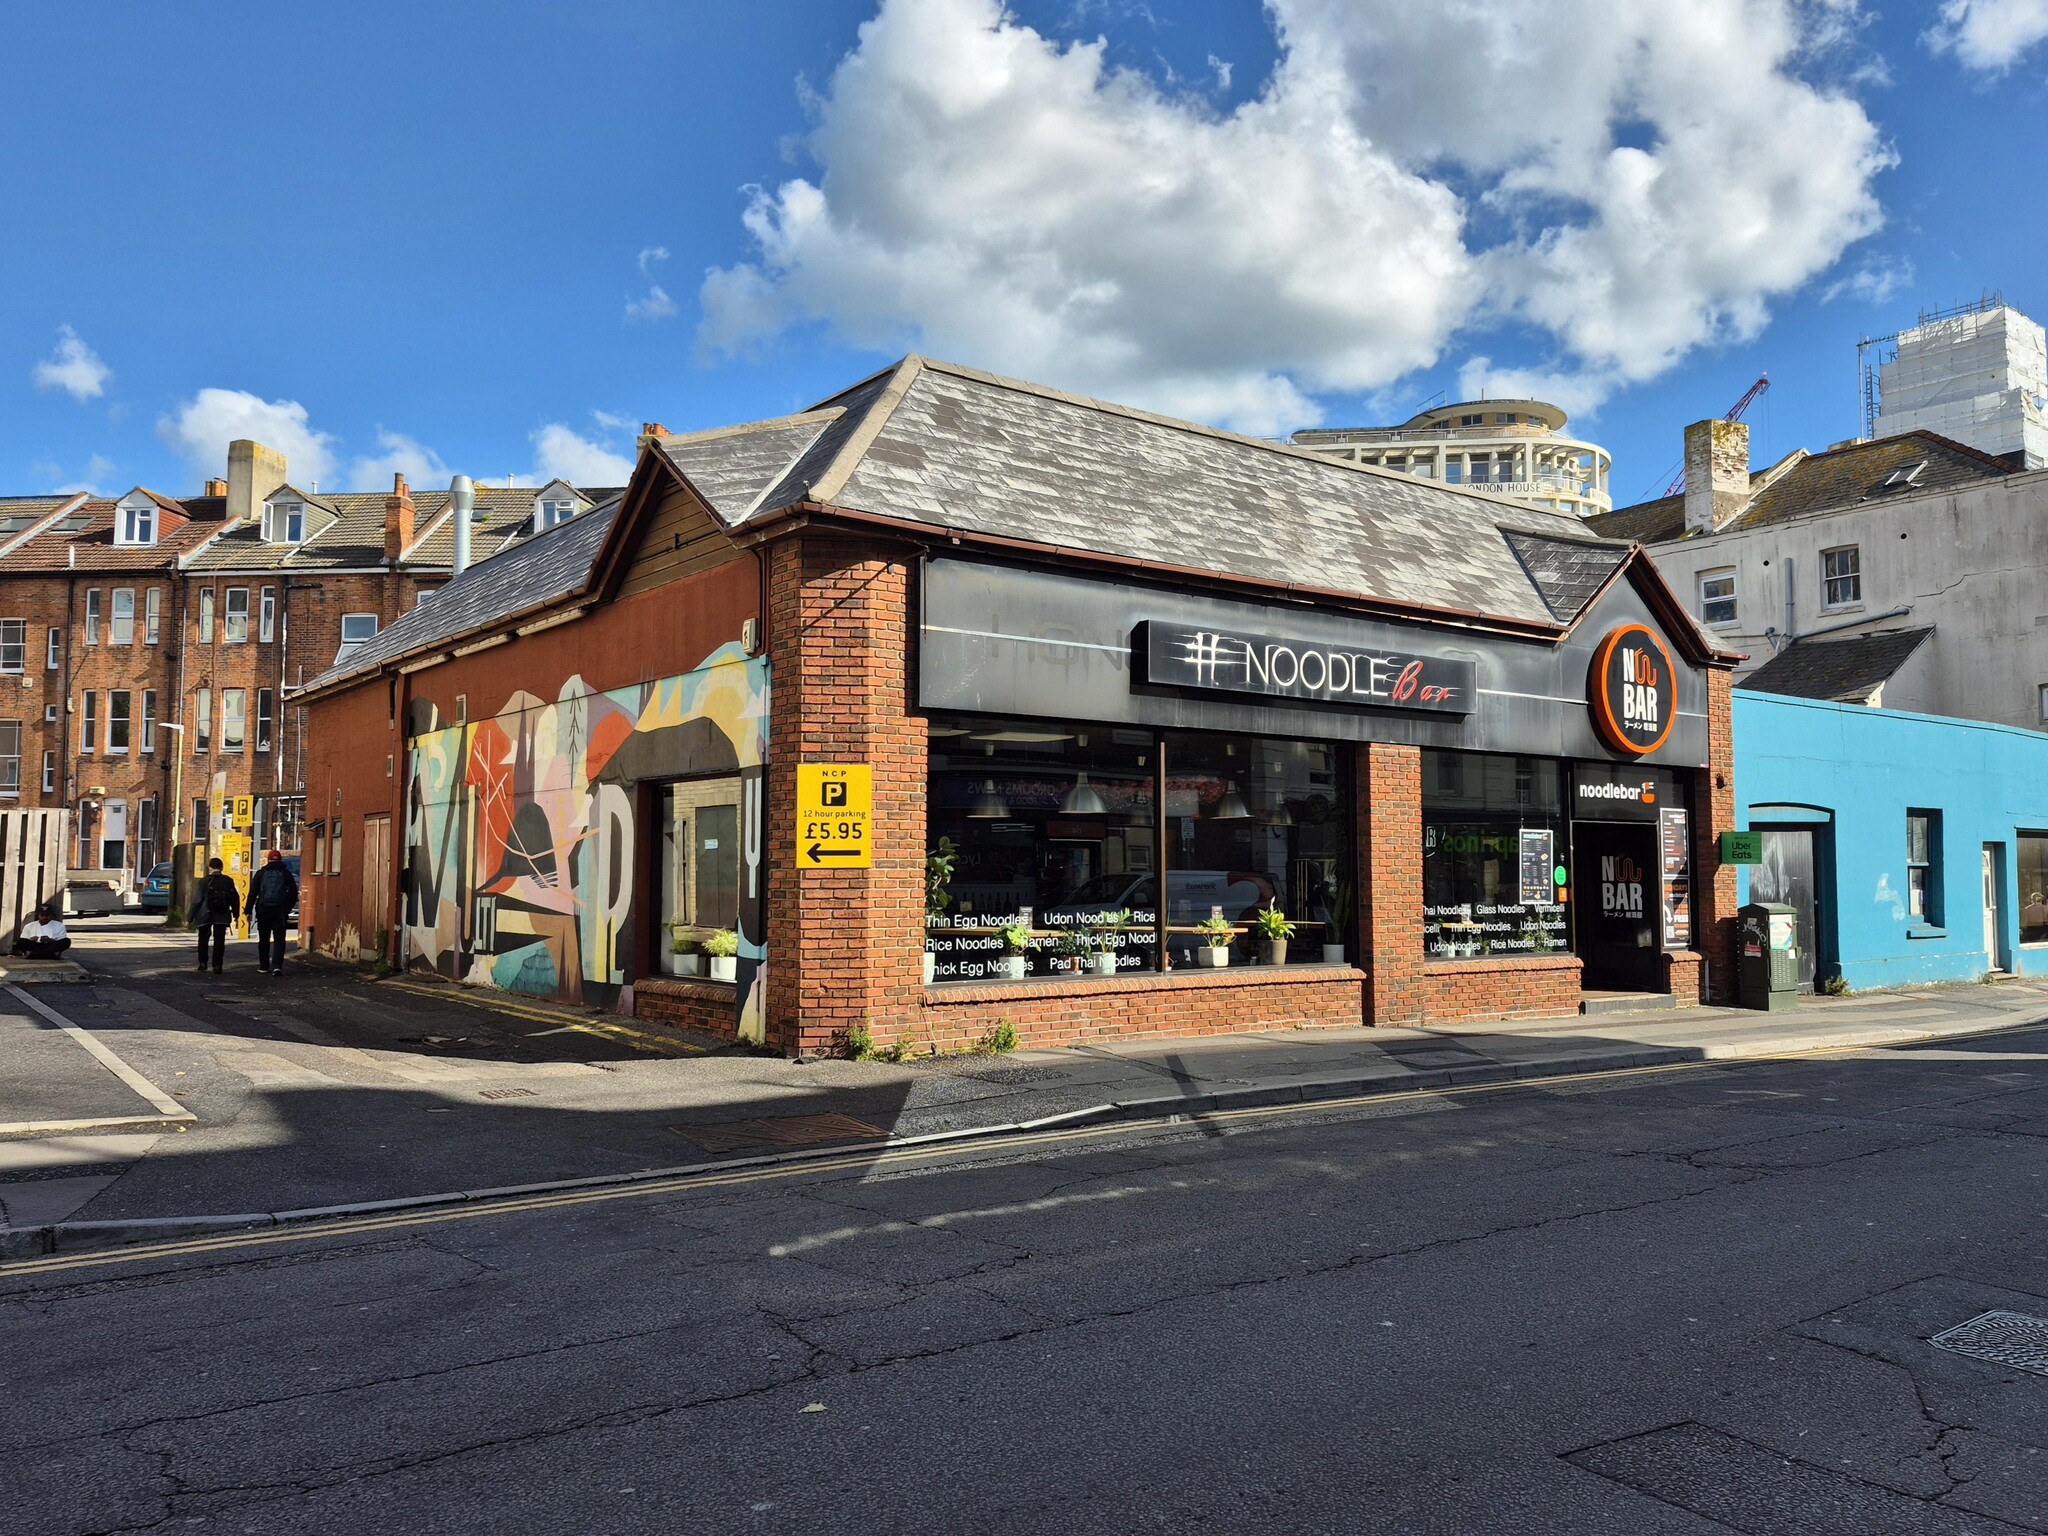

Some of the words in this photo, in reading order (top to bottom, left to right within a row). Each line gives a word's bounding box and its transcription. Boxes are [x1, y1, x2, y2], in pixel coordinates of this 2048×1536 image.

[1508, 482, 1541, 493] HOUSE
[1392, 660, 1452, 702] Bar
[1623, 683, 1658, 722] BAR
[1579, 782, 1641, 800] noodlebar
[803, 809, 813, 818] 12
[814, 809, 833, 818] hour
[835, 809, 867, 820] parking
[804, 822, 863, 840] £5.95
[1731, 841, 1752, 850] Uber
[1731, 850, 1752, 859] Eats
[1602, 882, 1643, 910] BAR
[1476, 904, 1496, 914] Glass
[1497, 904, 1526, 914] Noodles
[1534, 903, 1565, 913] Vermicelli
[925, 914, 951, 928] Thin
[954, 914, 978, 929] Egg
[981, 913, 1029, 927] Noodles
[1044, 912, 1073, 925] Udon
[1133, 910, 1156, 923] Rice
[1466, 923, 1481, 934] Egg
[1483, 921, 1511, 931] Noodles
[1520, 920, 1539, 931] Udon
[1540, 920, 1567, 930] Noodles
[925, 938, 953, 951] Rice
[955, 936, 1004, 950] Noodles
[1075, 933, 1102, 946] Thick
[1105, 932, 1126, 947] Egg
[1491, 939, 1507, 949] Rice
[1507, 938, 1535, 948] Noodles
[1543, 937, 1567, 947] Ramen
[960, 961, 984, 976] Egg
[1049, 957, 1071, 970] Pad
[1074, 956, 1096, 968] Thai
